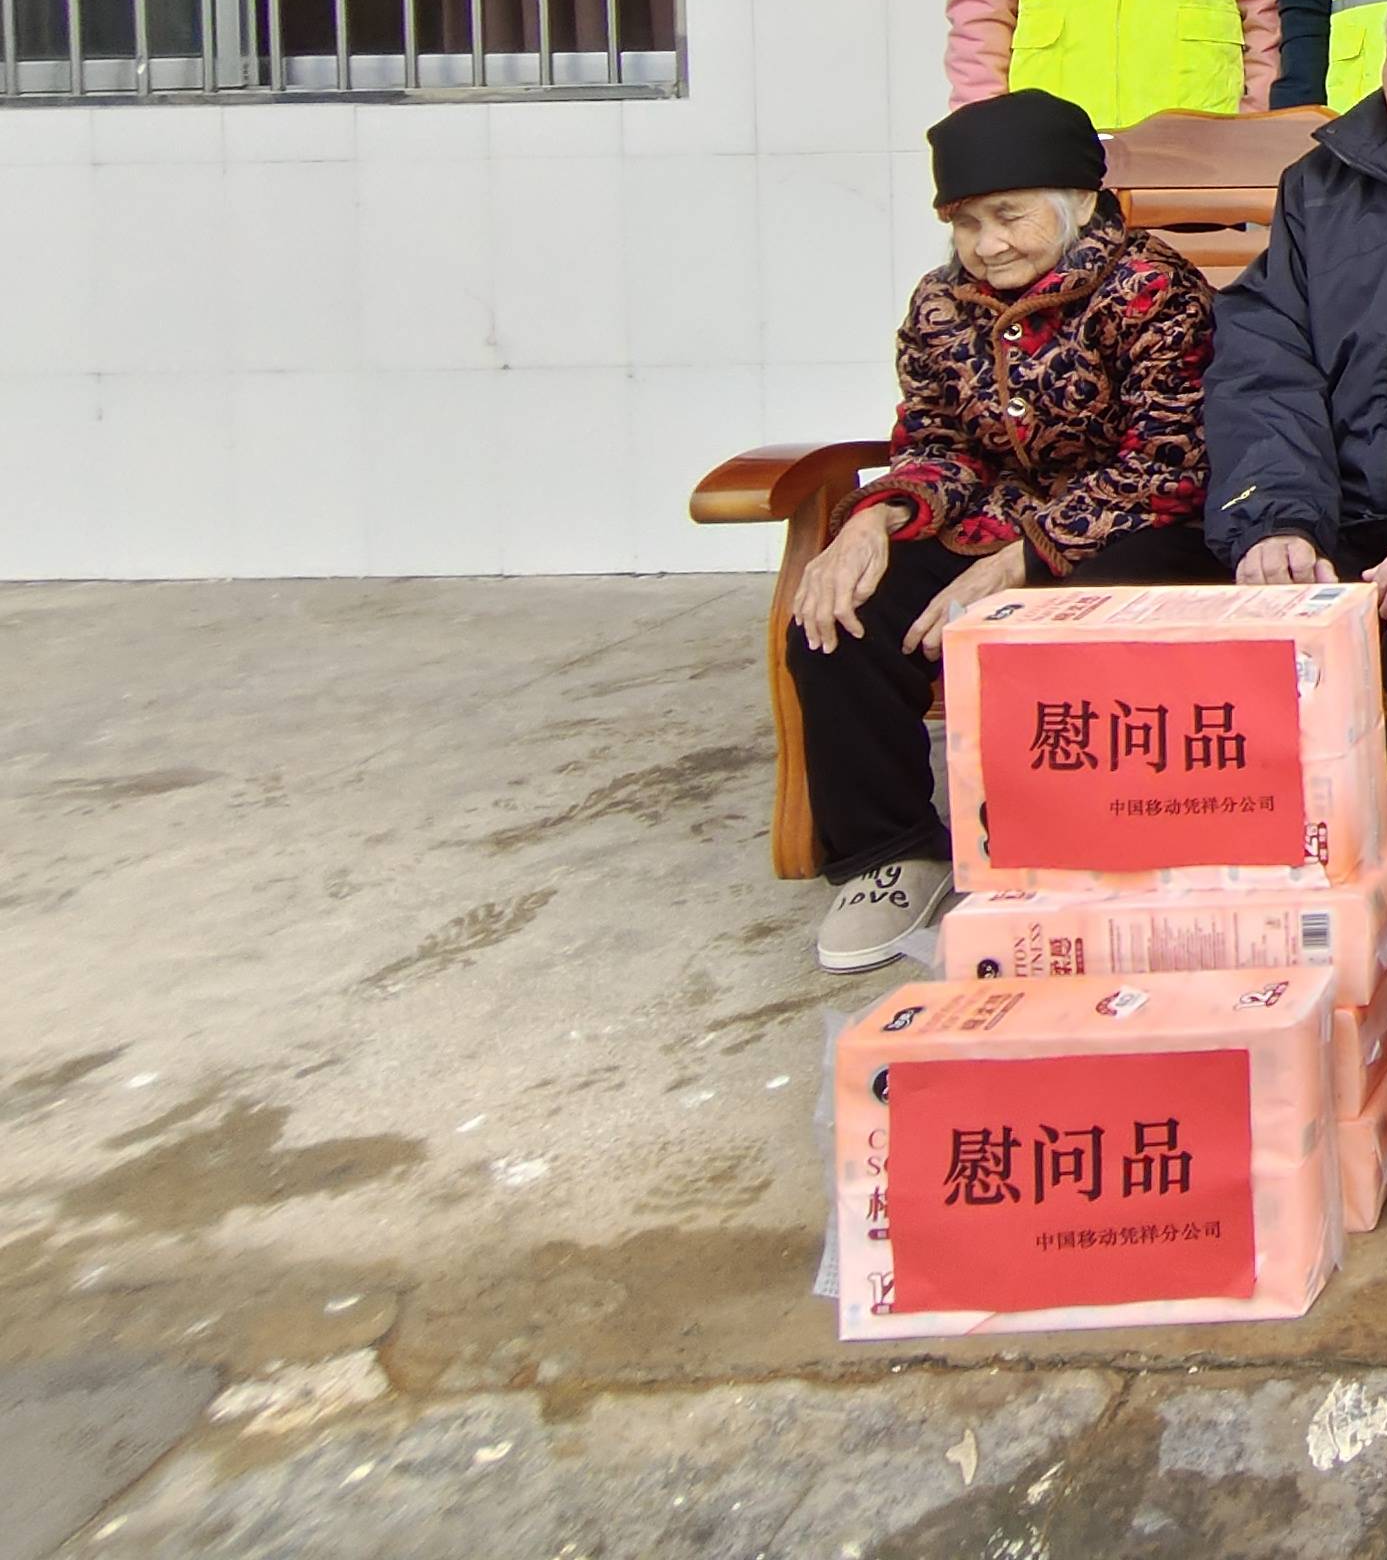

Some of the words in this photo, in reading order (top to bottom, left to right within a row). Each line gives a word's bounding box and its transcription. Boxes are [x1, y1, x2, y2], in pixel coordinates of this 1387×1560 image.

[1029, 699, 1247, 773] 慰问品
[1109, 795, 1275, 817] 中国移动凭祥分公司
[944, 1117, 1194, 1206] 慰问品
[1035, 1220, 1222, 1252] 中国移动凭祥分公司
